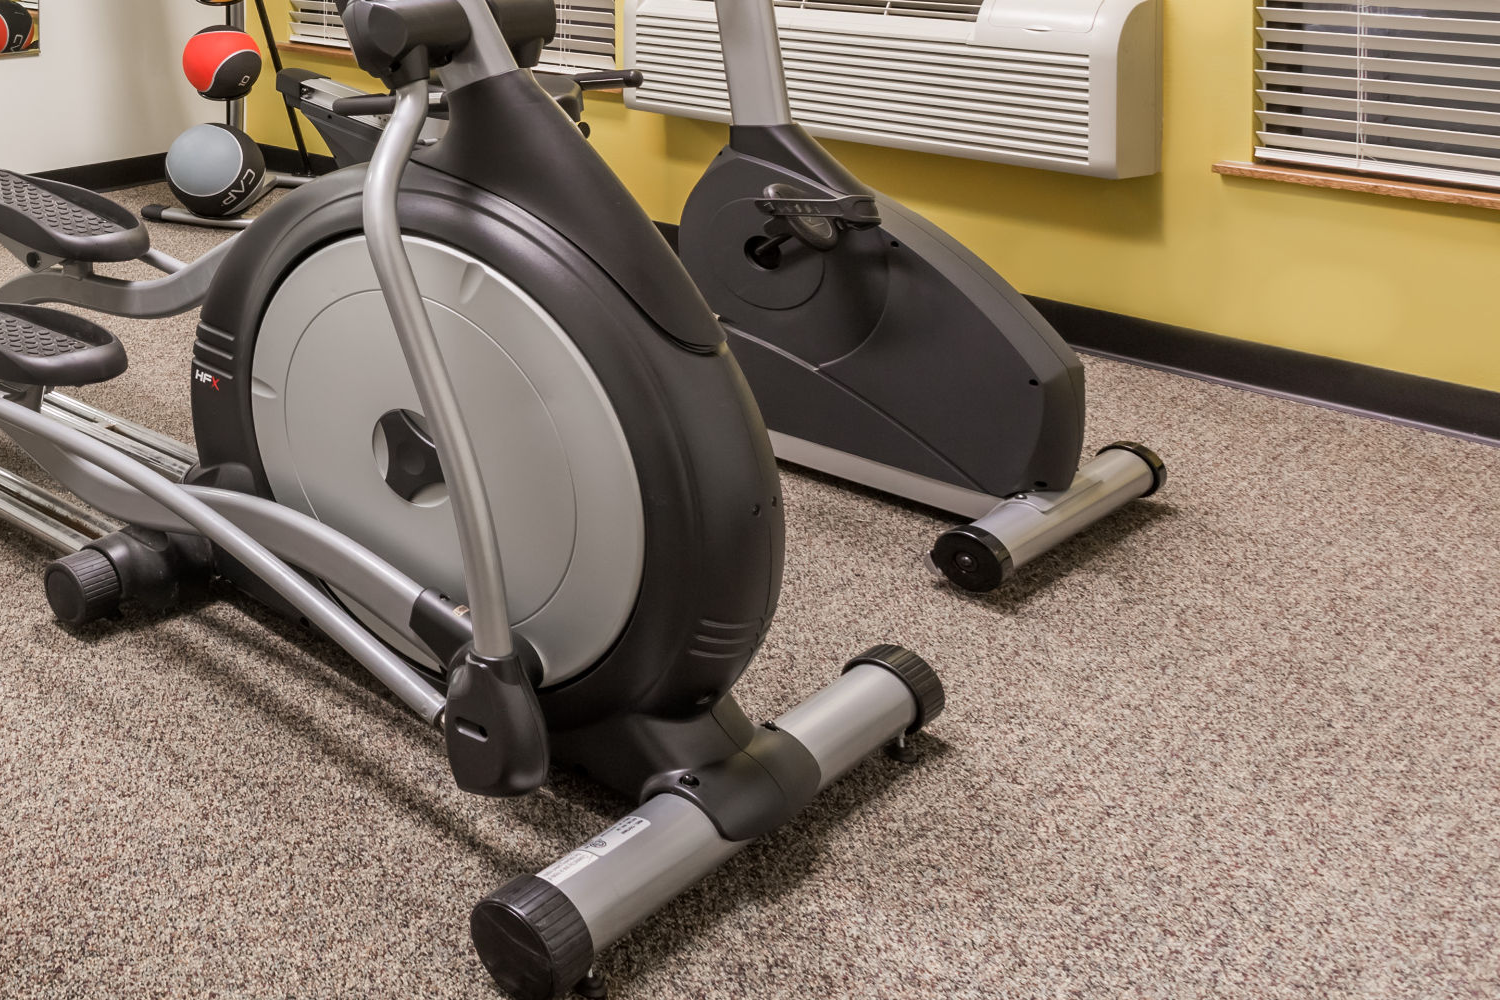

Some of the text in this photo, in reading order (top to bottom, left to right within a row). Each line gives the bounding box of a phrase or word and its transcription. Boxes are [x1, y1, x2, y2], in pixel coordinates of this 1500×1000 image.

[239, 75, 251, 87] 10
[221, 168, 256, 206] CAP
[195, 369, 220, 392] HFX
